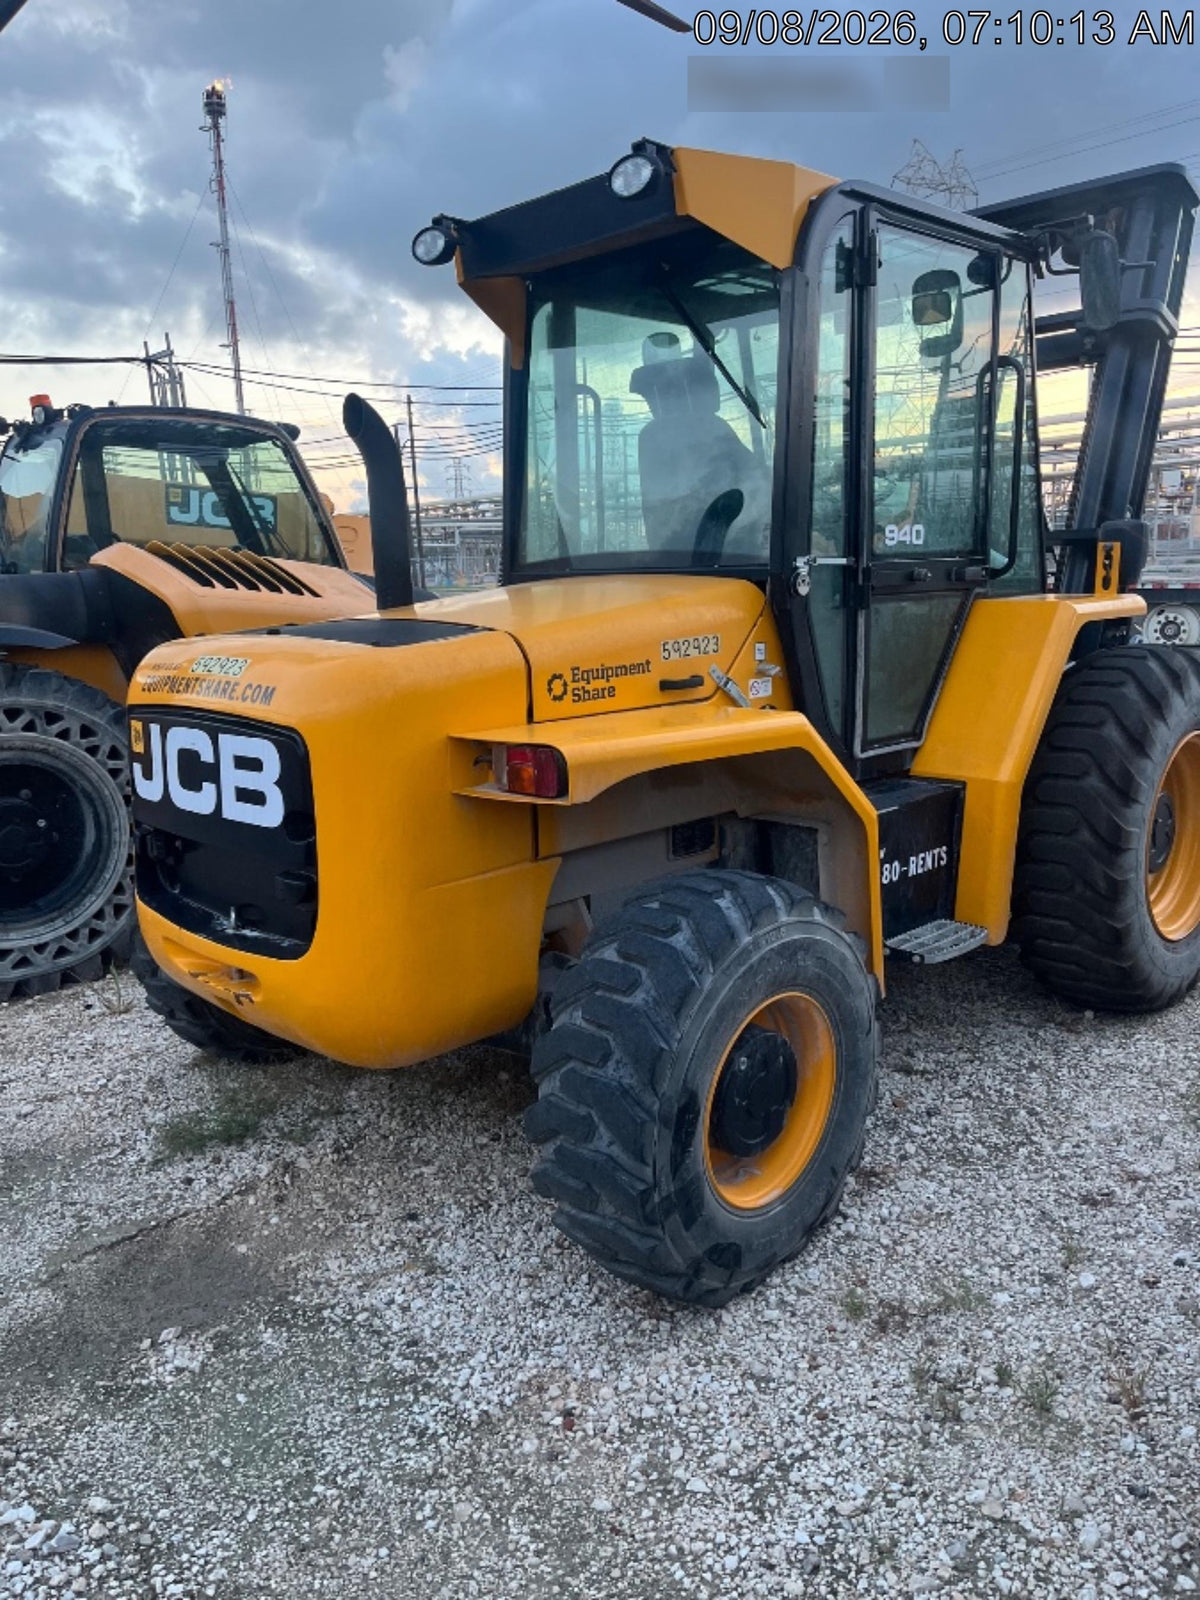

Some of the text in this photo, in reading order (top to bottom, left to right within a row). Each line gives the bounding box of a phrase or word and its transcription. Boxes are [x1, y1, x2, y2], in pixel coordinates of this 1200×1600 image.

[884, 524, 925, 546] 940
[662, 635, 719, 660] 592923
[191, 656, 248, 676] 592923
[570, 659, 651, 683] Equipment
[141, 675, 276, 706] EQUIPMENTSHARE.COM
[571, 685, 616, 703] Share
[132, 722, 285, 828] JCB
[881, 846, 947, 884] 80-RENTS
